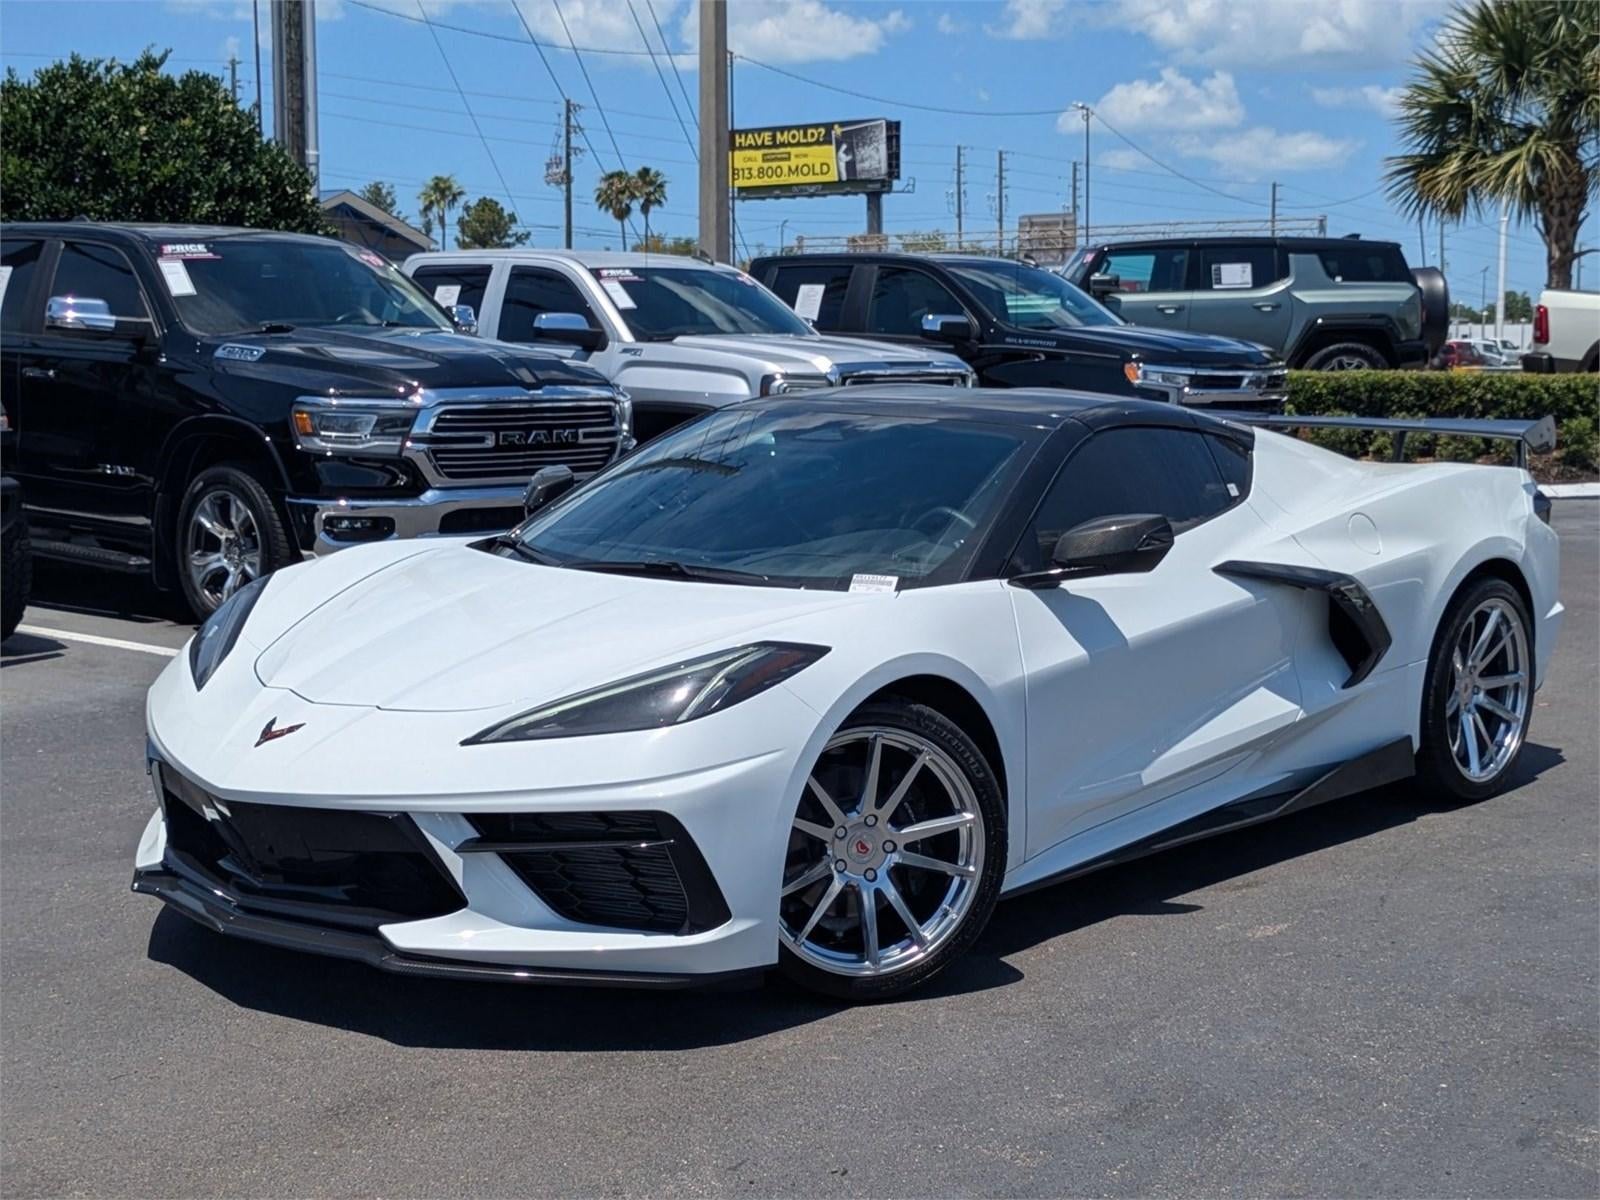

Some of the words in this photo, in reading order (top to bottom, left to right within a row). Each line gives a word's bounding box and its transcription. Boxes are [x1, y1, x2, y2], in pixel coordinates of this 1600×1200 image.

[735, 132, 773, 147] HAVE
[776, 128, 826, 144] MOLD?
[499, 428, 577, 445] RAM
